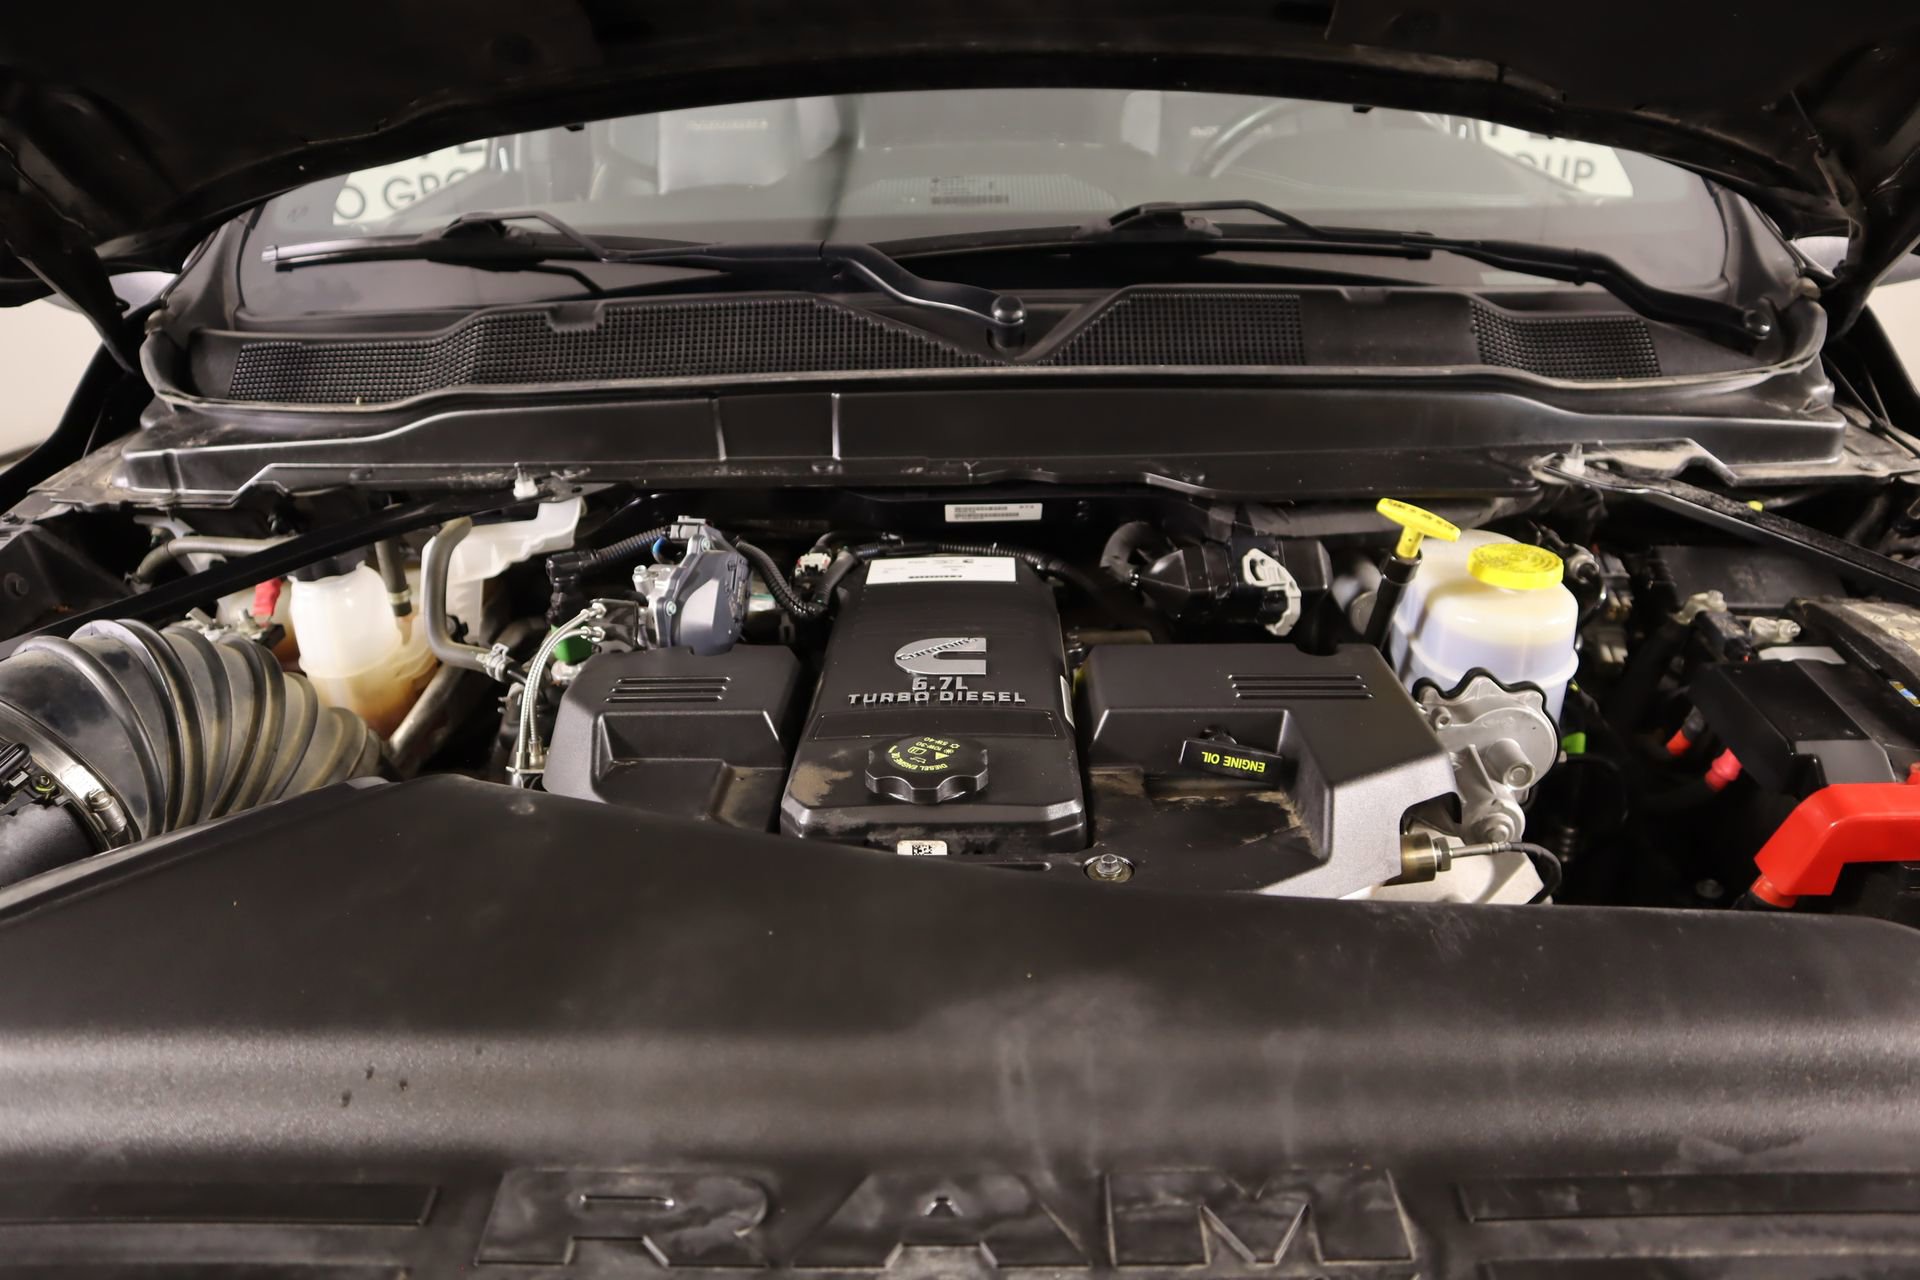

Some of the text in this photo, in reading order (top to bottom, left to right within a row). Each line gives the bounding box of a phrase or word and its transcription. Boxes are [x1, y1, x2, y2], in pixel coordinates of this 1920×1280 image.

[912, 676, 969, 691] 6.7L
[848, 690, 1026, 705] TURBO DIESEL
[919, 763, 948, 771] DIESEL
[1201, 751, 1266, 773] ENGINE OIL
[475, 1168, 1415, 1267] RAM
